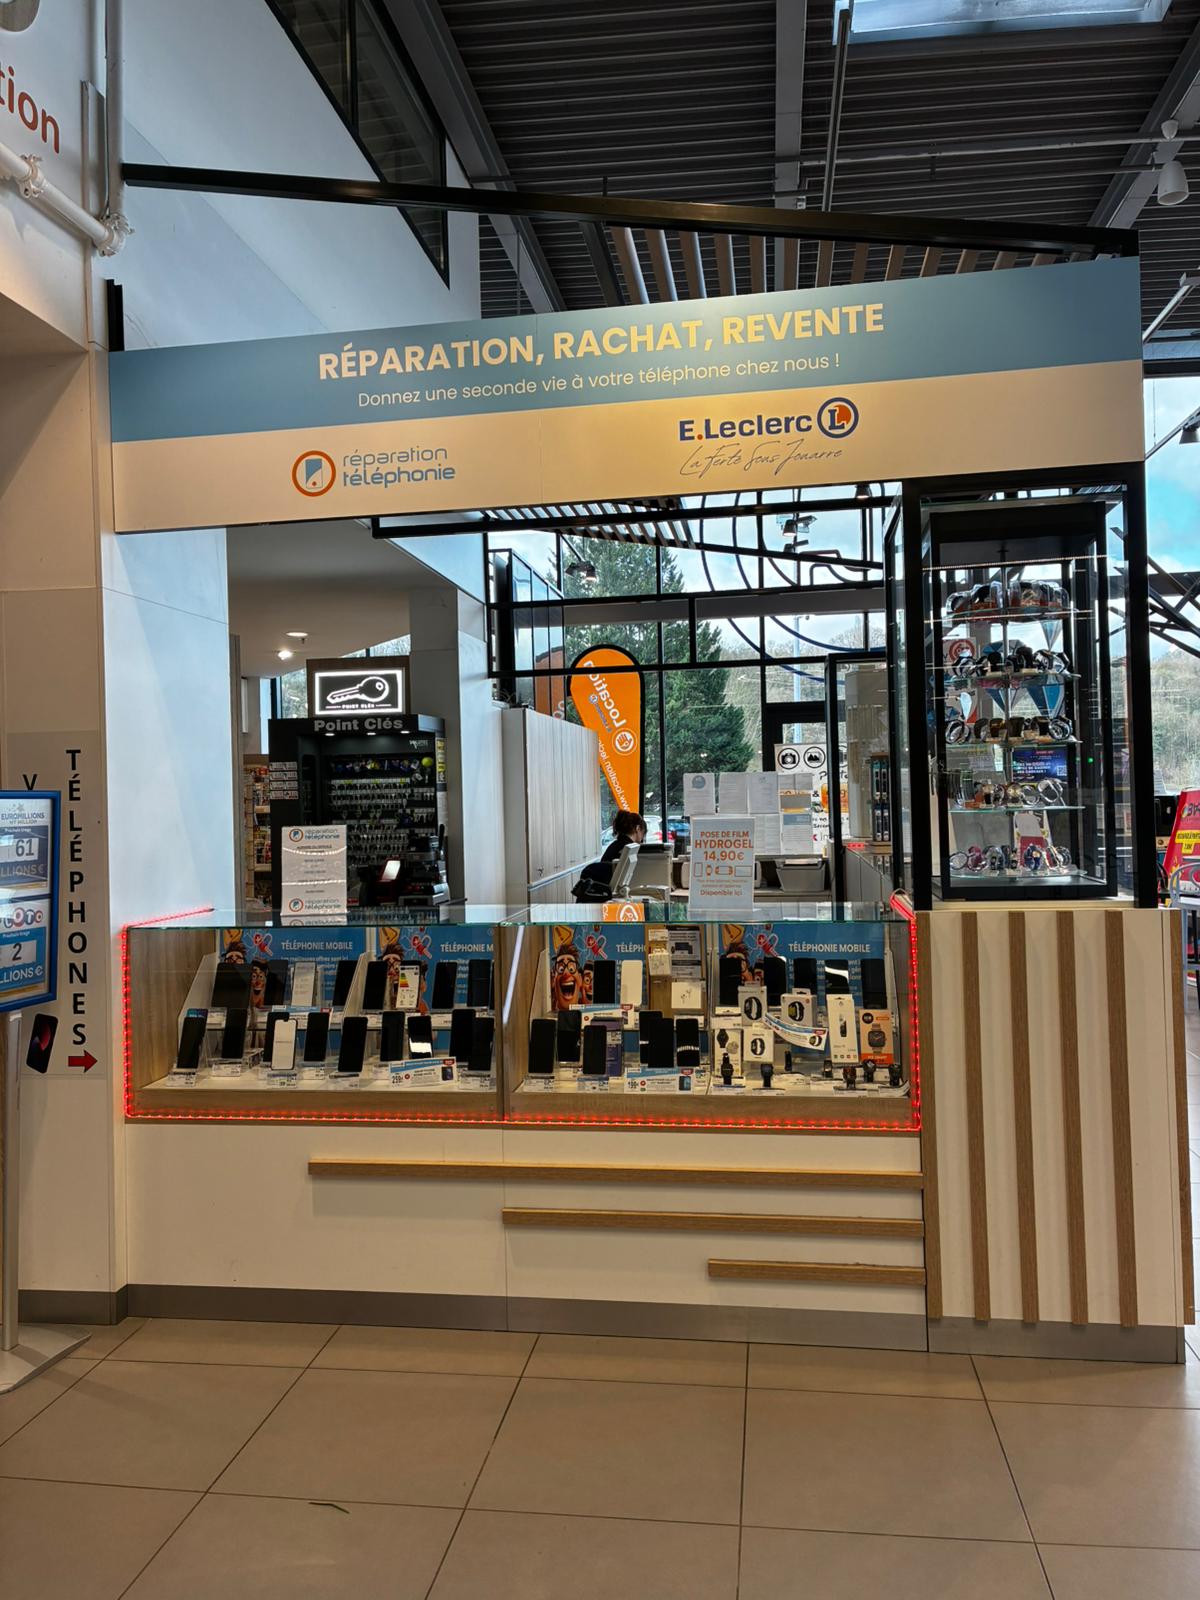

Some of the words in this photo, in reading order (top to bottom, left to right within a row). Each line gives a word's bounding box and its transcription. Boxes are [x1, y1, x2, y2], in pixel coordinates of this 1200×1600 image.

[319, 335, 544, 381] RÉPARATION,
[553, 319, 713, 359] RACHAT,
[722, 303, 884, 345] REVENTE
[358, 391, 421, 407] Donnez
[425, 386, 457, 401] une
[462, 379, 537, 399] seconde
[541, 376, 567, 392] vie
[572, 373, 584, 389] à
[588, 369, 634, 388] votre
[638, 364, 731, 385] téléphone
[735, 359, 779, 377] chez
[784, 355, 830, 372] nous
[679, 414, 813, 442] E.Leclerc
[343, 445, 448, 468] réparation
[343, 463, 456, 489] téléphonie
[314, 719, 359, 732] Point
[364, 717, 404, 730] Clés
[1, 812, 45, 820] EUROMILLIONS
[15, 838, 35, 858] 61
[694, 839, 754, 849] HYDROGEL
[66, 749, 88, 1046] TÉLÉPHONES
[12, 942, 22, 961] 2
[281, 940, 324, 950] TÉLÉPHONIE
[325, 941, 353, 950] MOBILE
[440, 941, 485, 952] TÉLÉPHONIE
[616, 942, 646, 953] TÉLÉPH
[788, 941, 838, 953] TÉLÉPHONIE
[839, 943, 871, 953] MOBILE
